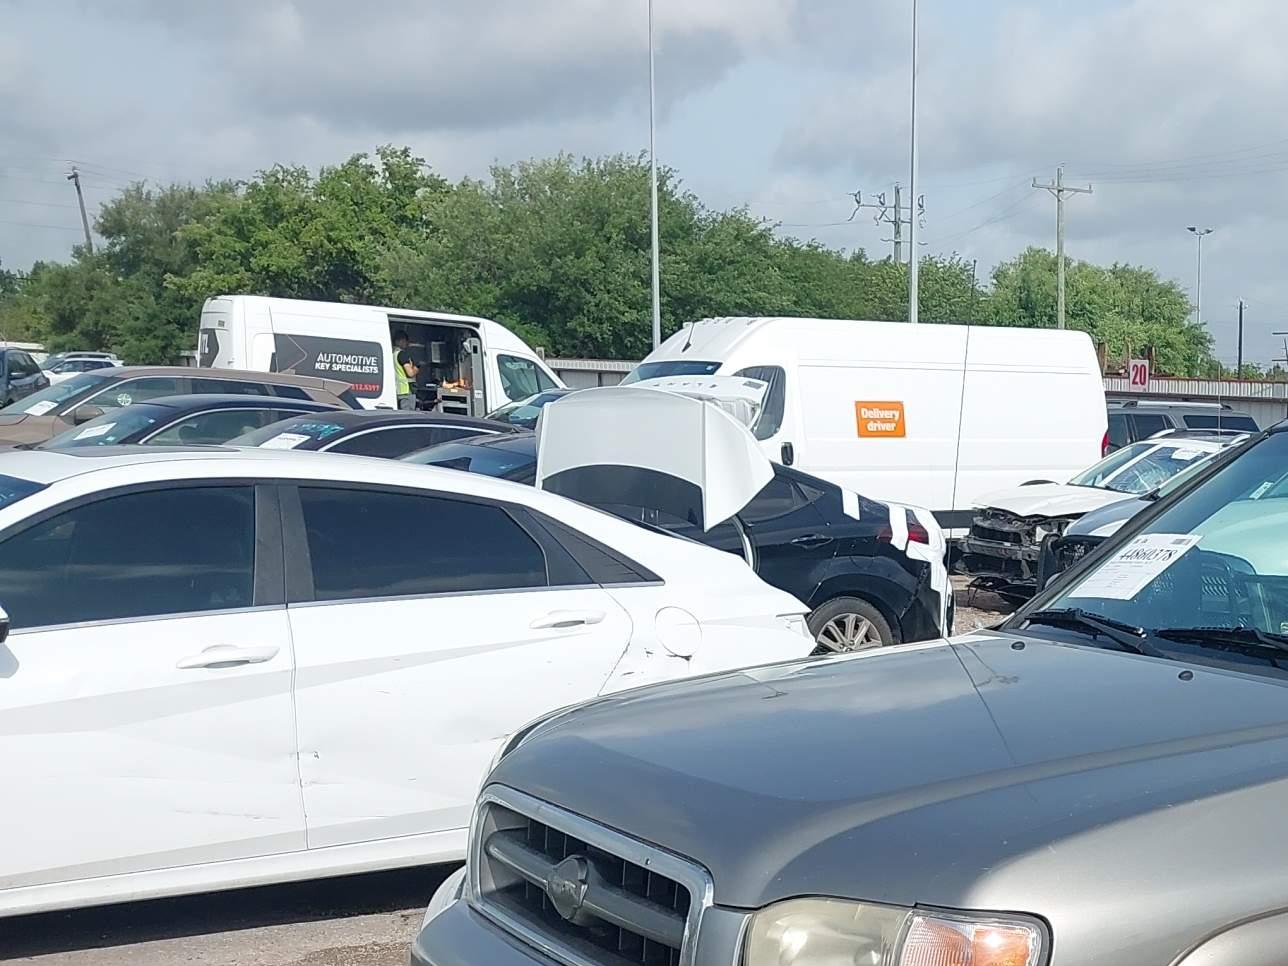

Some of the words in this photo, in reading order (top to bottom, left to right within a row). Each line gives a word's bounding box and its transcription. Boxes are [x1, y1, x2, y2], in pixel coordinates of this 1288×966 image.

[316, 352, 378, 366] AUTOMOTIVE
[314, 362, 331, 371] KEY
[331, 363, 379, 374] SPECIALISTS
[1131, 363, 1147, 386] 20
[860, 407, 900, 420] Delivery
[866, 420, 897, 432] driver
